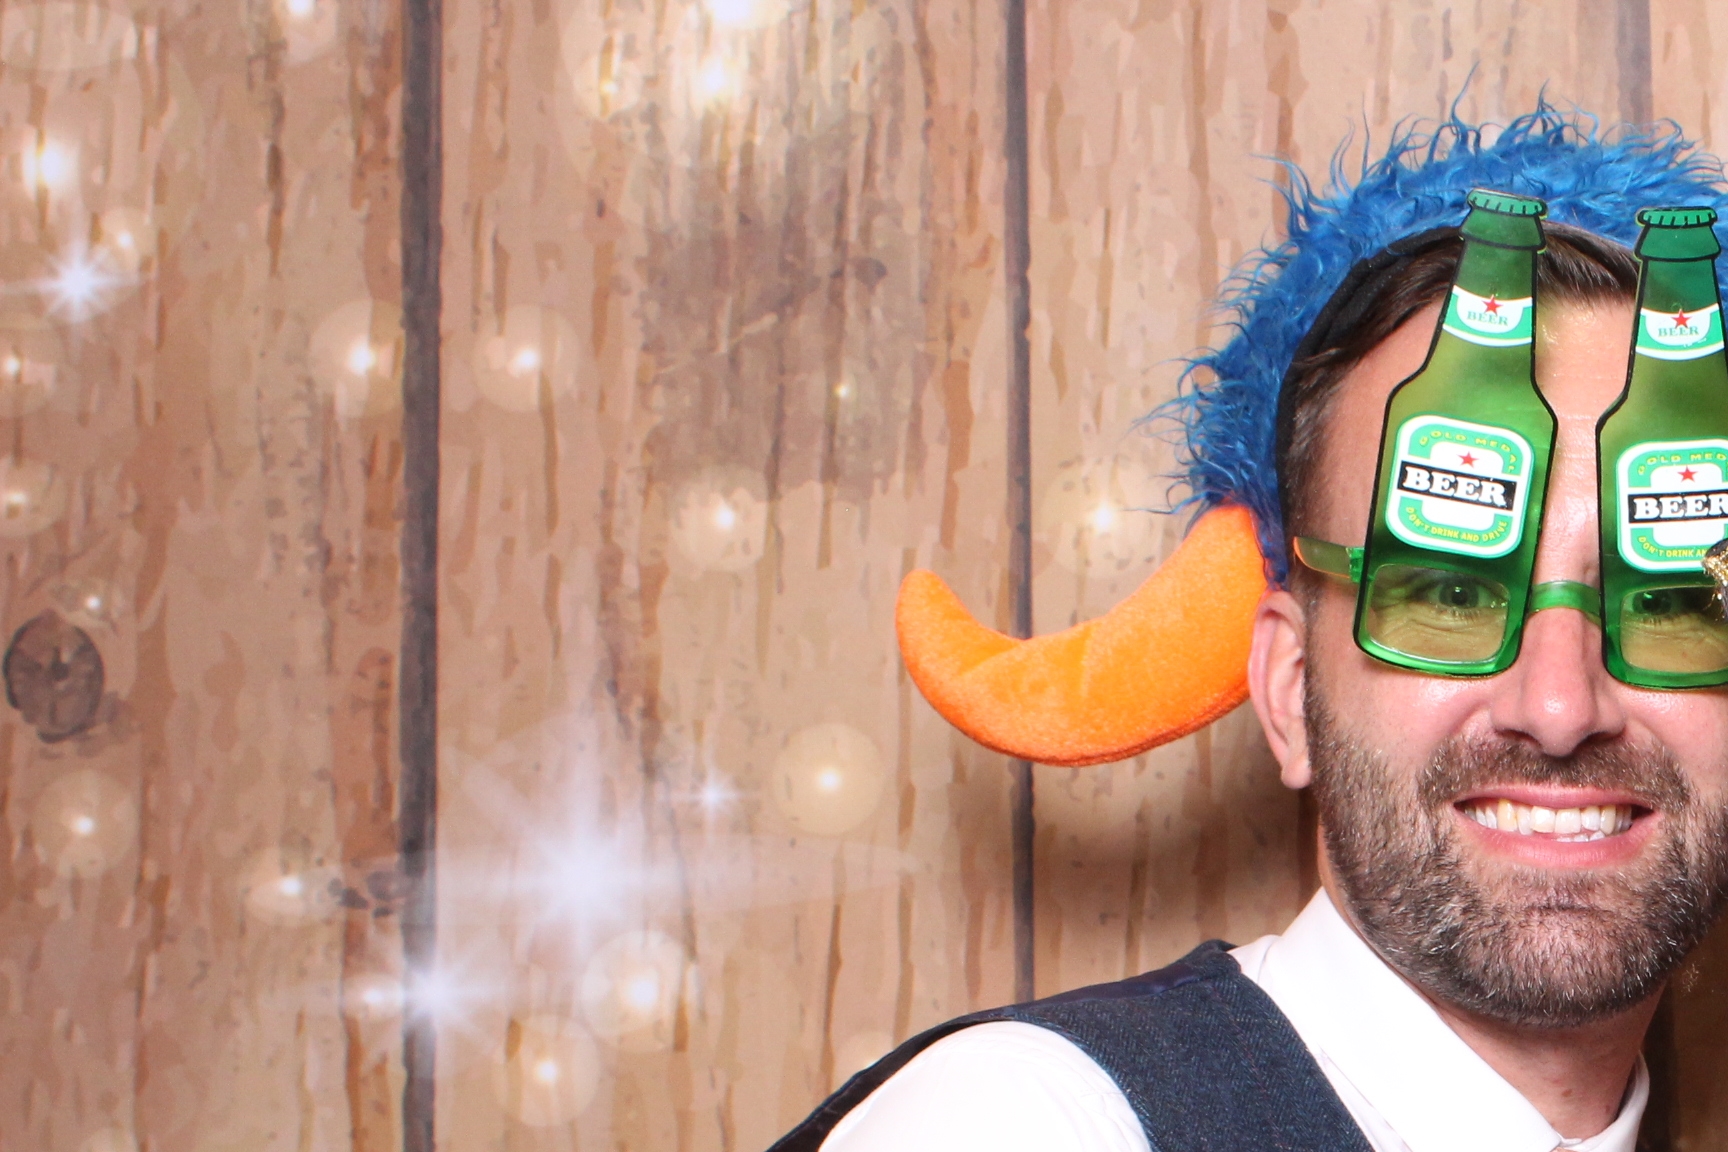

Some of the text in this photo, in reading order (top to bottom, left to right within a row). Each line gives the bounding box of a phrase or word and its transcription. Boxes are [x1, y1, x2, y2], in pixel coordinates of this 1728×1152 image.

[1467, 310, 1509, 327] BEER
[1658, 325, 1699, 338] BEER
[1419, 430, 1517, 473] GOLD MEDAL
[1637, 454, 1682, 476] GOLD
[1402, 465, 1508, 508] BEER
[1405, 506, 1508, 543] DON'T DRINK AND DRIVE
[1638, 536, 1664, 557] DON'T
[1666, 548, 1694, 558] DRINK
